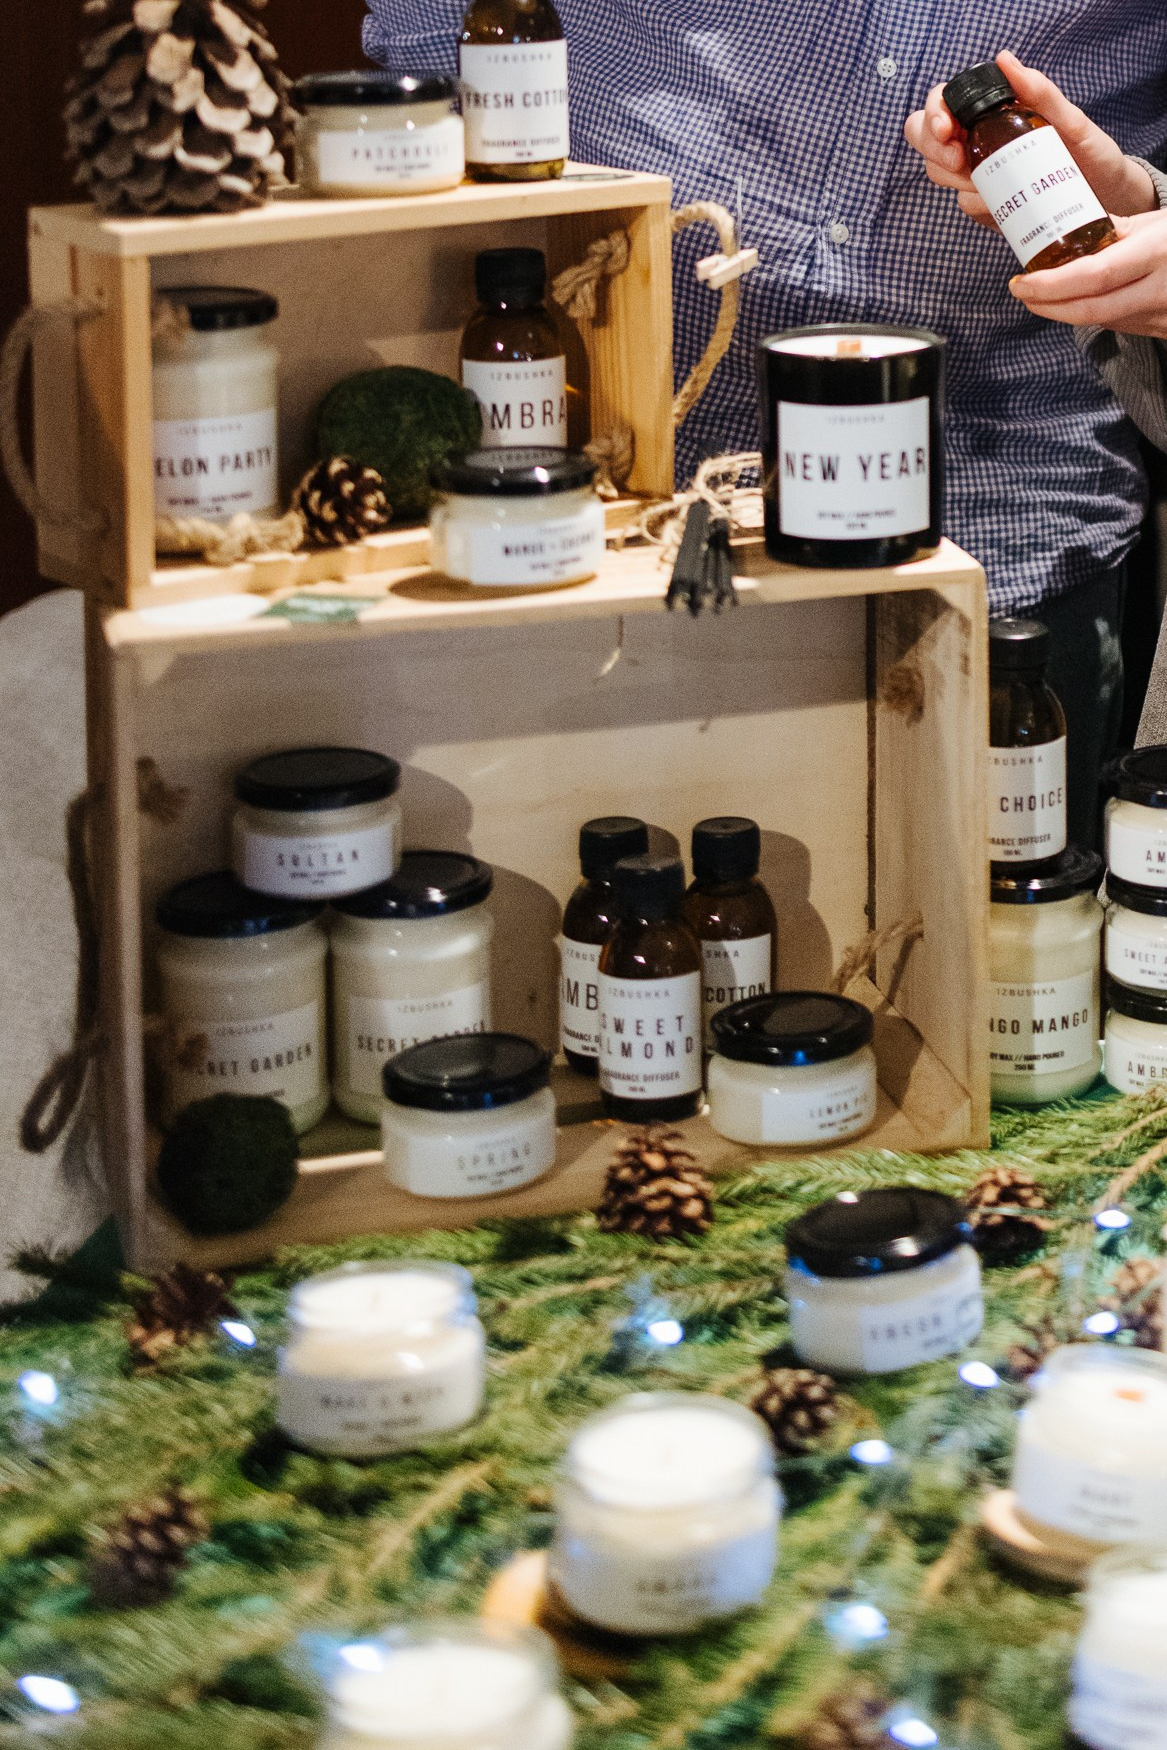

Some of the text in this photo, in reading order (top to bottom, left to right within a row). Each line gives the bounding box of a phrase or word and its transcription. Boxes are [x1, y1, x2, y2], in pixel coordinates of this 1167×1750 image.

[464, 91, 514, 109] FRESH
[985, 140, 1037, 176] IZBUSHKA
[994, 164, 1079, 226] SECRET GARDEN
[1020, 203, 1084, 248] FRAGRANC DIFFUSER
[154, 446, 272, 479] ELON PARTY
[784, 446, 927, 482] NEW YEAR
[1000, 788, 1063, 813] CHOICE
[1018, 833, 1052, 847] DIFFUSER
[277, 850, 359, 868] SULTAN
[1124, 947, 1157, 965] SWEET
[561, 977, 599, 1011] MB
[608, 987, 671, 998] IZBUSHKA
[705, 982, 765, 1003] COTTON
[996, 987, 1056, 998] IZBUSHKA
[601, 1013, 684, 1036] SWEET
[1032, 1008, 1088, 1034] MANGO
[357, 1035, 418, 1052] SECRET
[600, 1036, 694, 1060] LMOND
[250, 1042, 312, 1074] GARDEN
[643, 1070, 680, 1083] DIFFUSER
[1127, 1061, 1167, 1079] AMBR
